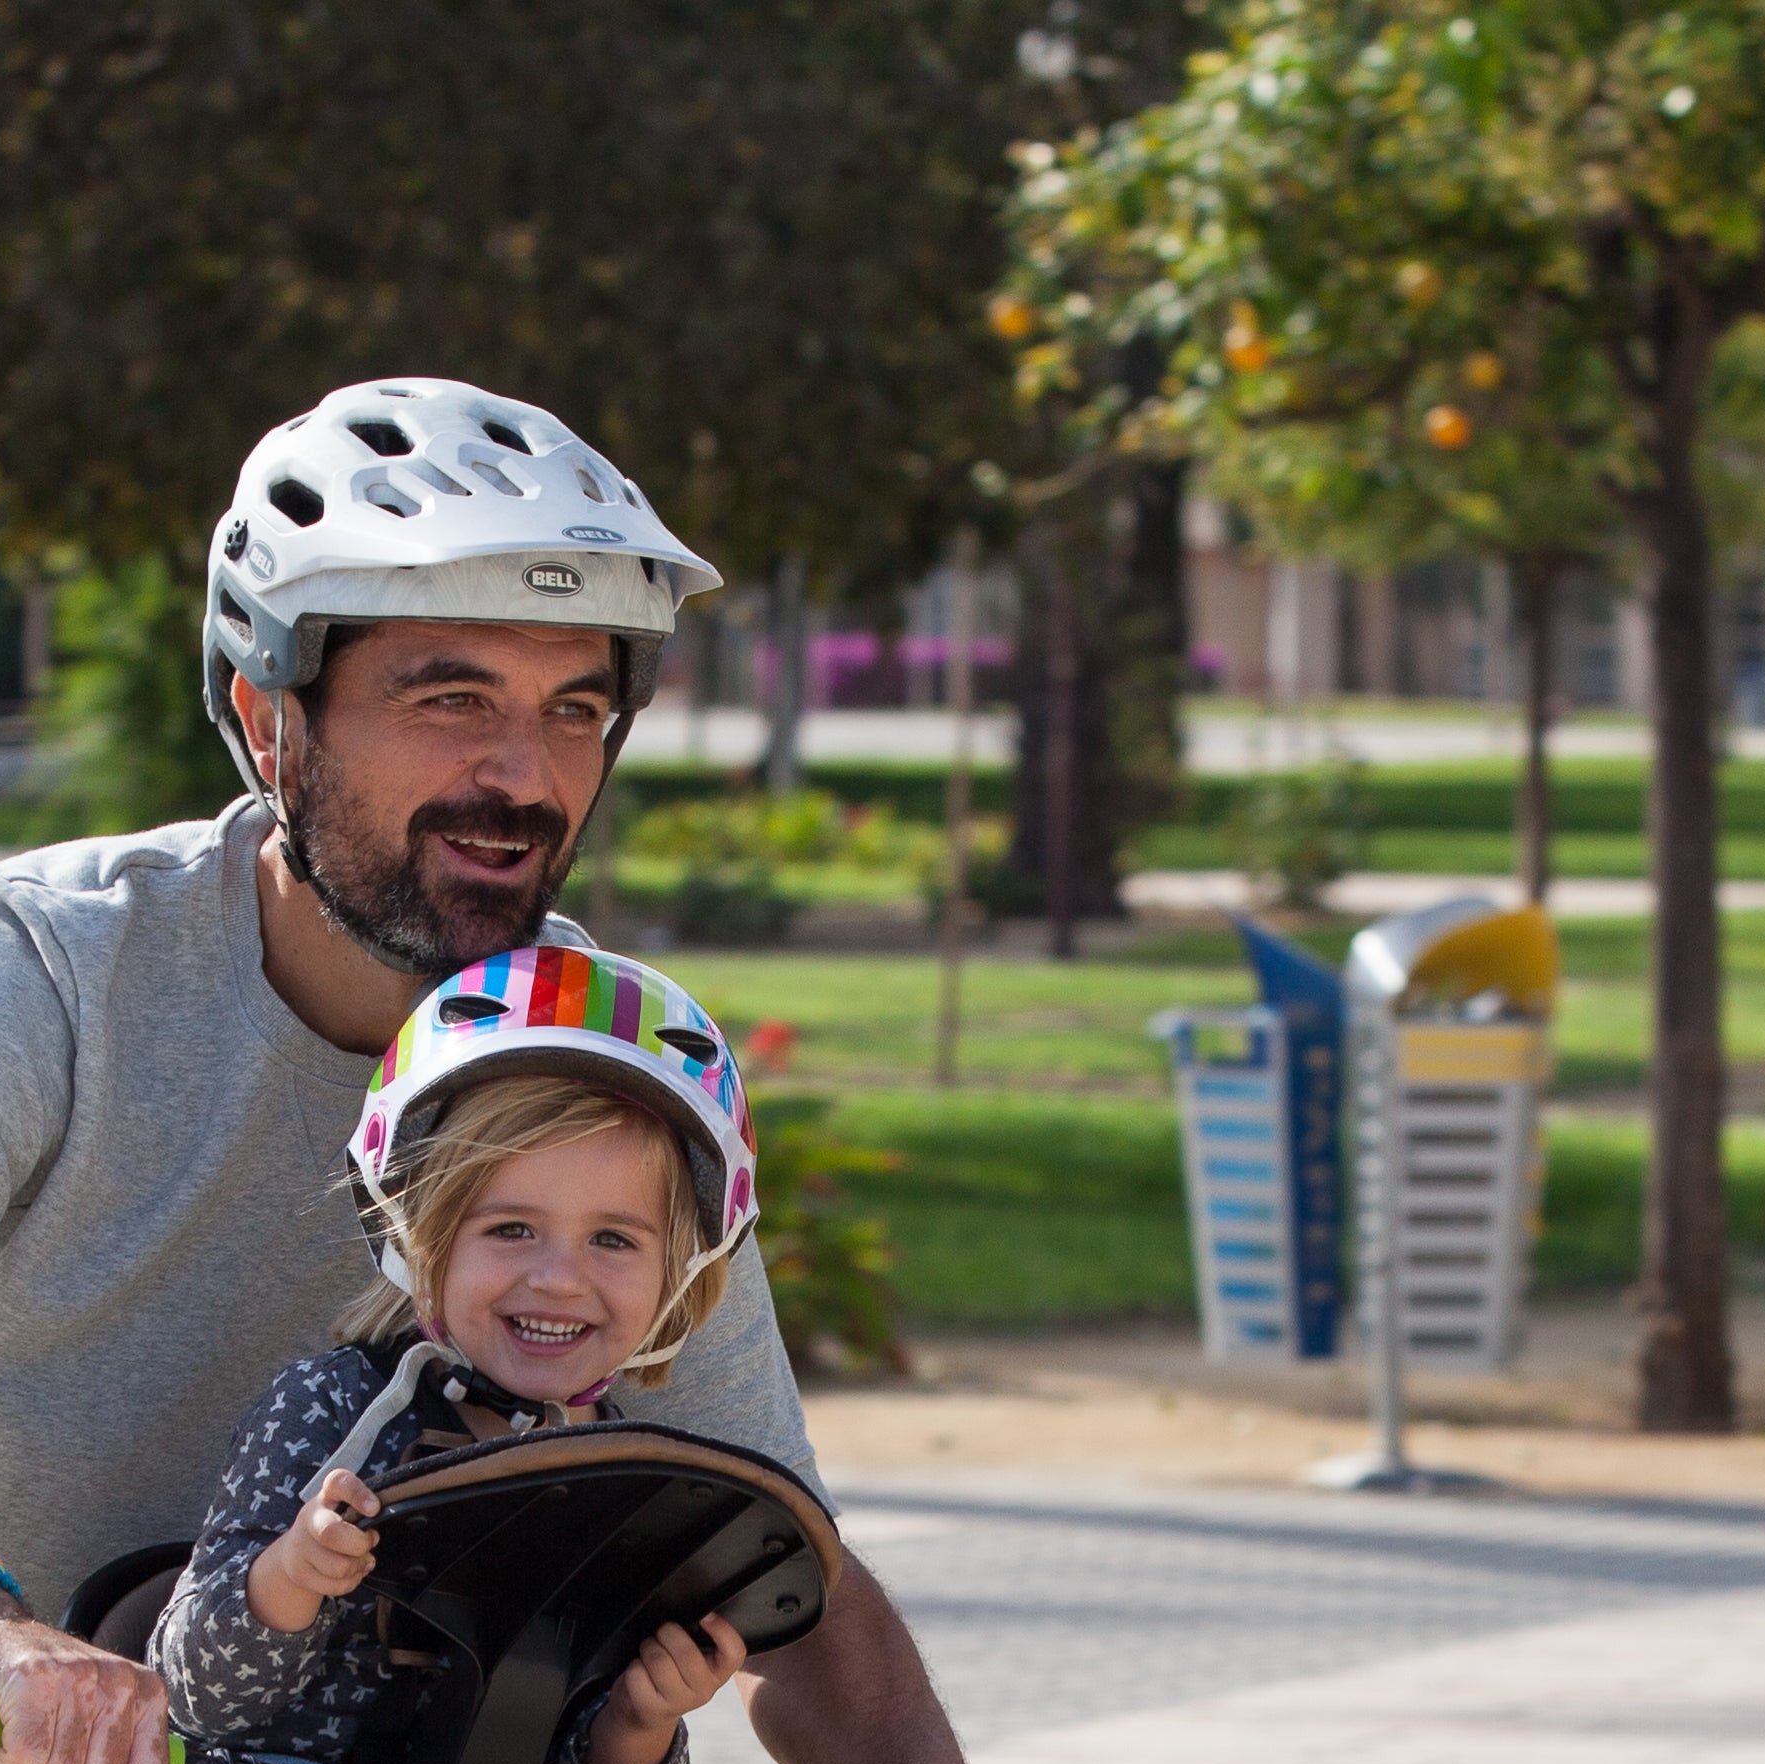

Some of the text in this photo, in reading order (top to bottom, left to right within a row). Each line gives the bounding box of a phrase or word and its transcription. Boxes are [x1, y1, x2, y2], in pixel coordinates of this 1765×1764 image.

[571, 529, 619, 541] BELL
[249, 546, 272, 578] BELL
[532, 570, 578, 589] BELL
